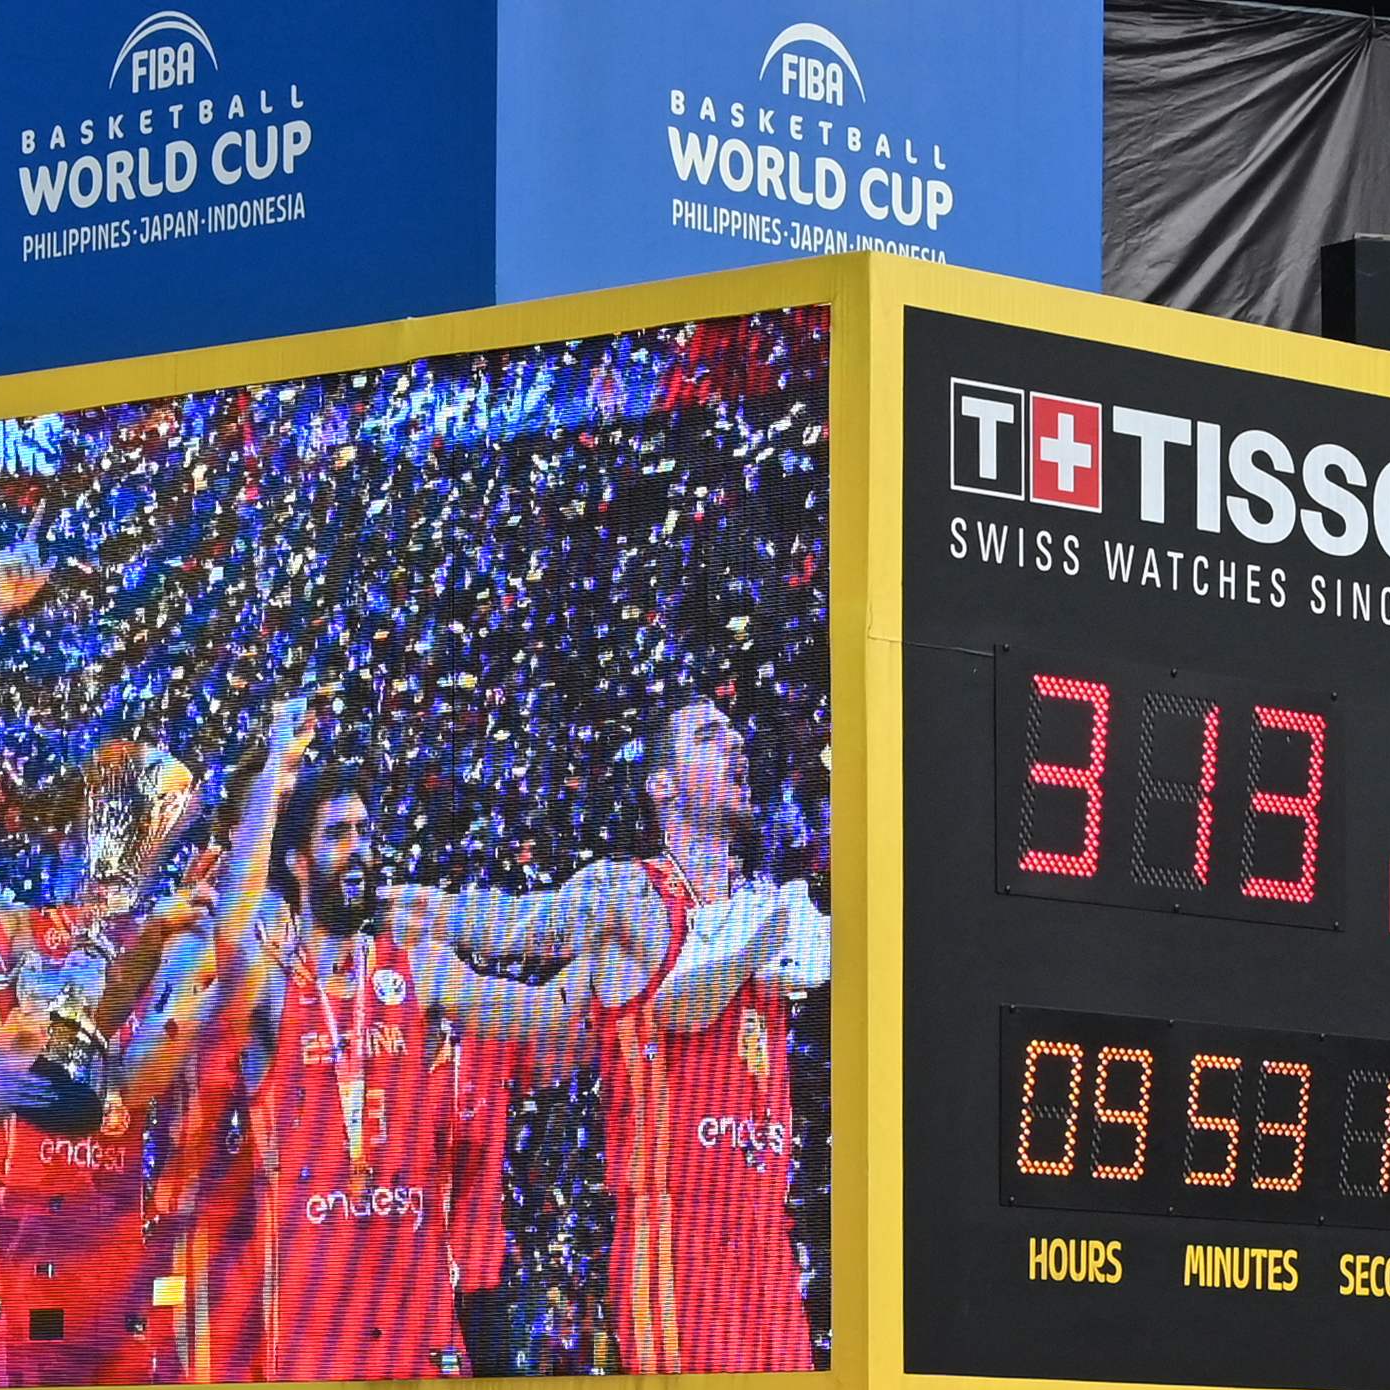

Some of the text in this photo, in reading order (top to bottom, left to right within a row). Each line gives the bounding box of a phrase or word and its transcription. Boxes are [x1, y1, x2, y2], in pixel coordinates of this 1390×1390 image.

[131, 41, 196, 94] FIBA
[780, 52, 845, 107] FIBA
[20, 83, 305, 155] BASKETBALL
[669, 88, 947, 171] BASKETBALL
[18, 119, 313, 217] WORLD CUP
[666, 125, 954, 232] WORLD CUP
[949, 515, 1081, 578] SWISS
[1104, 539, 1289, 610] WATCHES
[1017, 672, 1328, 905] 313
[1016, 1039, 1154, 1182] 09
[1182, 1054, 1312, 1192] 53
[1028, 1236, 1125, 1285] HOURS
[1183, 1244, 1300, 1293] MINUTES
